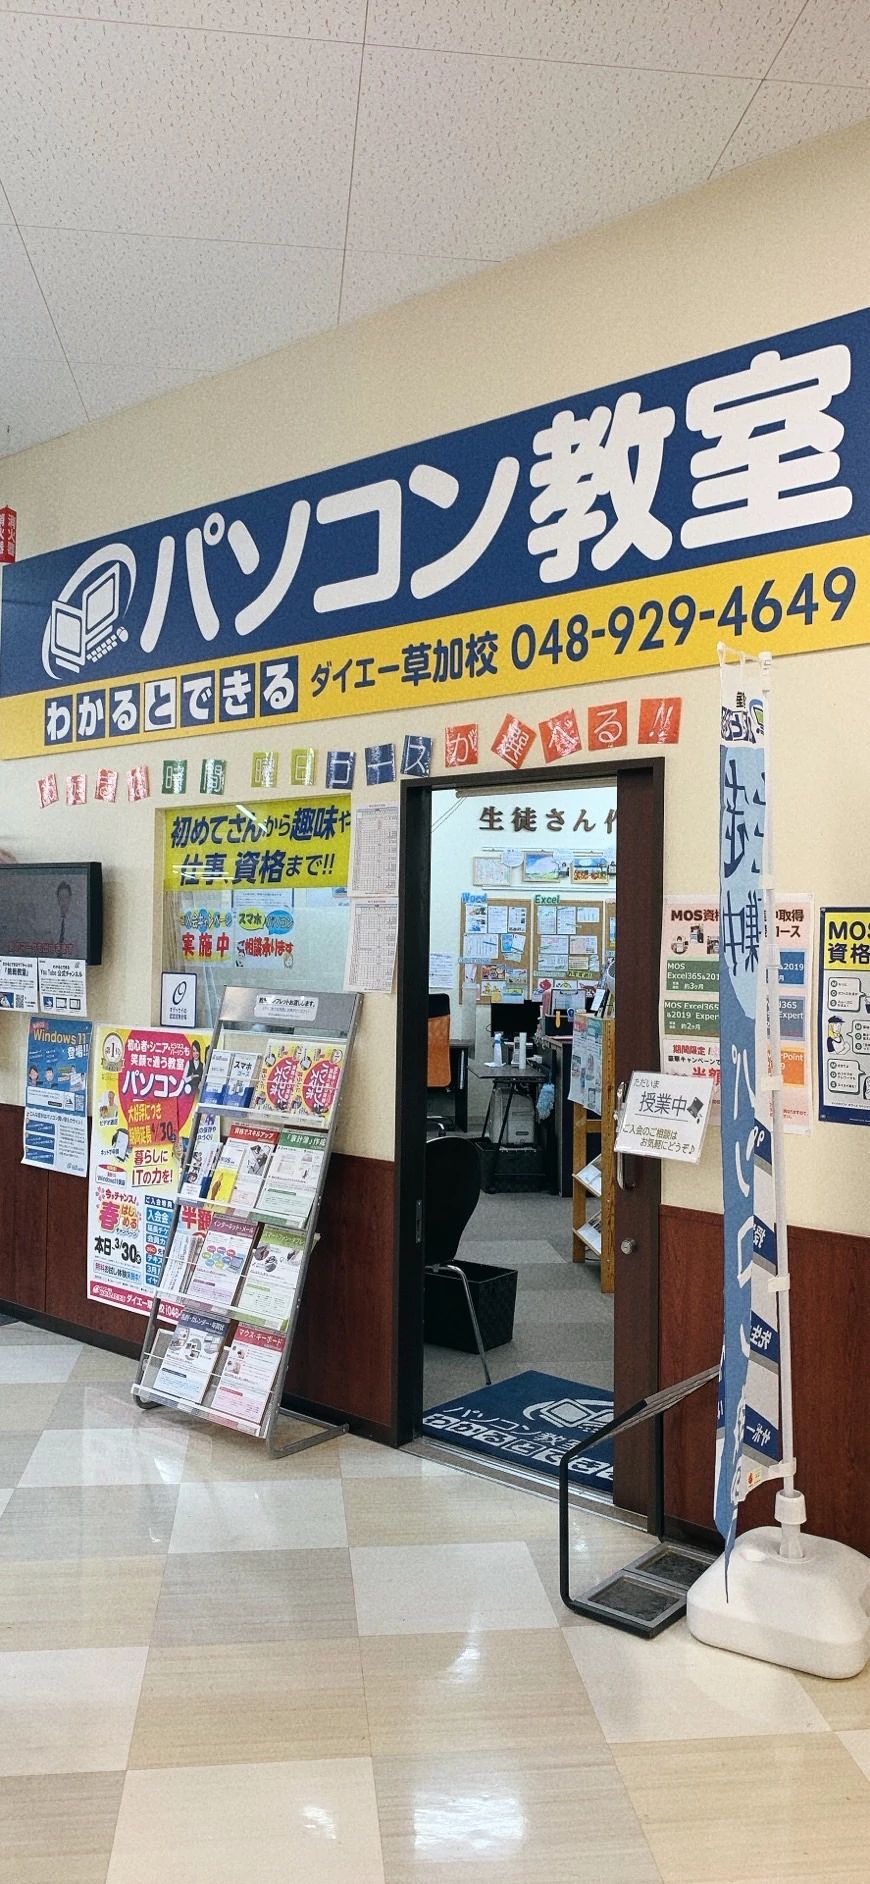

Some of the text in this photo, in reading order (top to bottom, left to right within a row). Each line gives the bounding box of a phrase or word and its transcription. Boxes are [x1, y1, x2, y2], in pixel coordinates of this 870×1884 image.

[140, 344, 853, 653] パソコン教室
[311, 566, 857, 697] ダイエー草加校 048-929-4649
[46, 661, 294, 742] わかるとできる
[171, 805, 350, 848] 初めてさんから趣味や
[461, 892, 487, 904] Word
[535, 895, 560, 904] Excel
[238, 912, 263, 926] スマホ
[775, 909, 805, 922] 取得
[182, 932, 230, 958] 実施中
[664, 1001, 719, 1011] MOS Excel365
[33, 1028, 86, 1045] Windows 11
[67, 1044, 89, 1060] 登場!!
[130, 1053, 185, 1071] 笑顔で通う教室
[233, 1061, 252, 1071] スマホ
[270, 1066, 283, 1096] スマホ
[306, 1070, 320, 1099] スマホ
[633, 1079, 660, 1088] ただいま
[638, 1091, 687, 1117] 授業中
[622, 1124, 678, 1141] ご入会のご相談は
[134, 1149, 168, 1165] 暮らしに
[132, 1167, 173, 1185] ITの力を!
[99, 1200, 120, 1231] 春
[239, 1328, 284, 1346] マウス・キーボード
